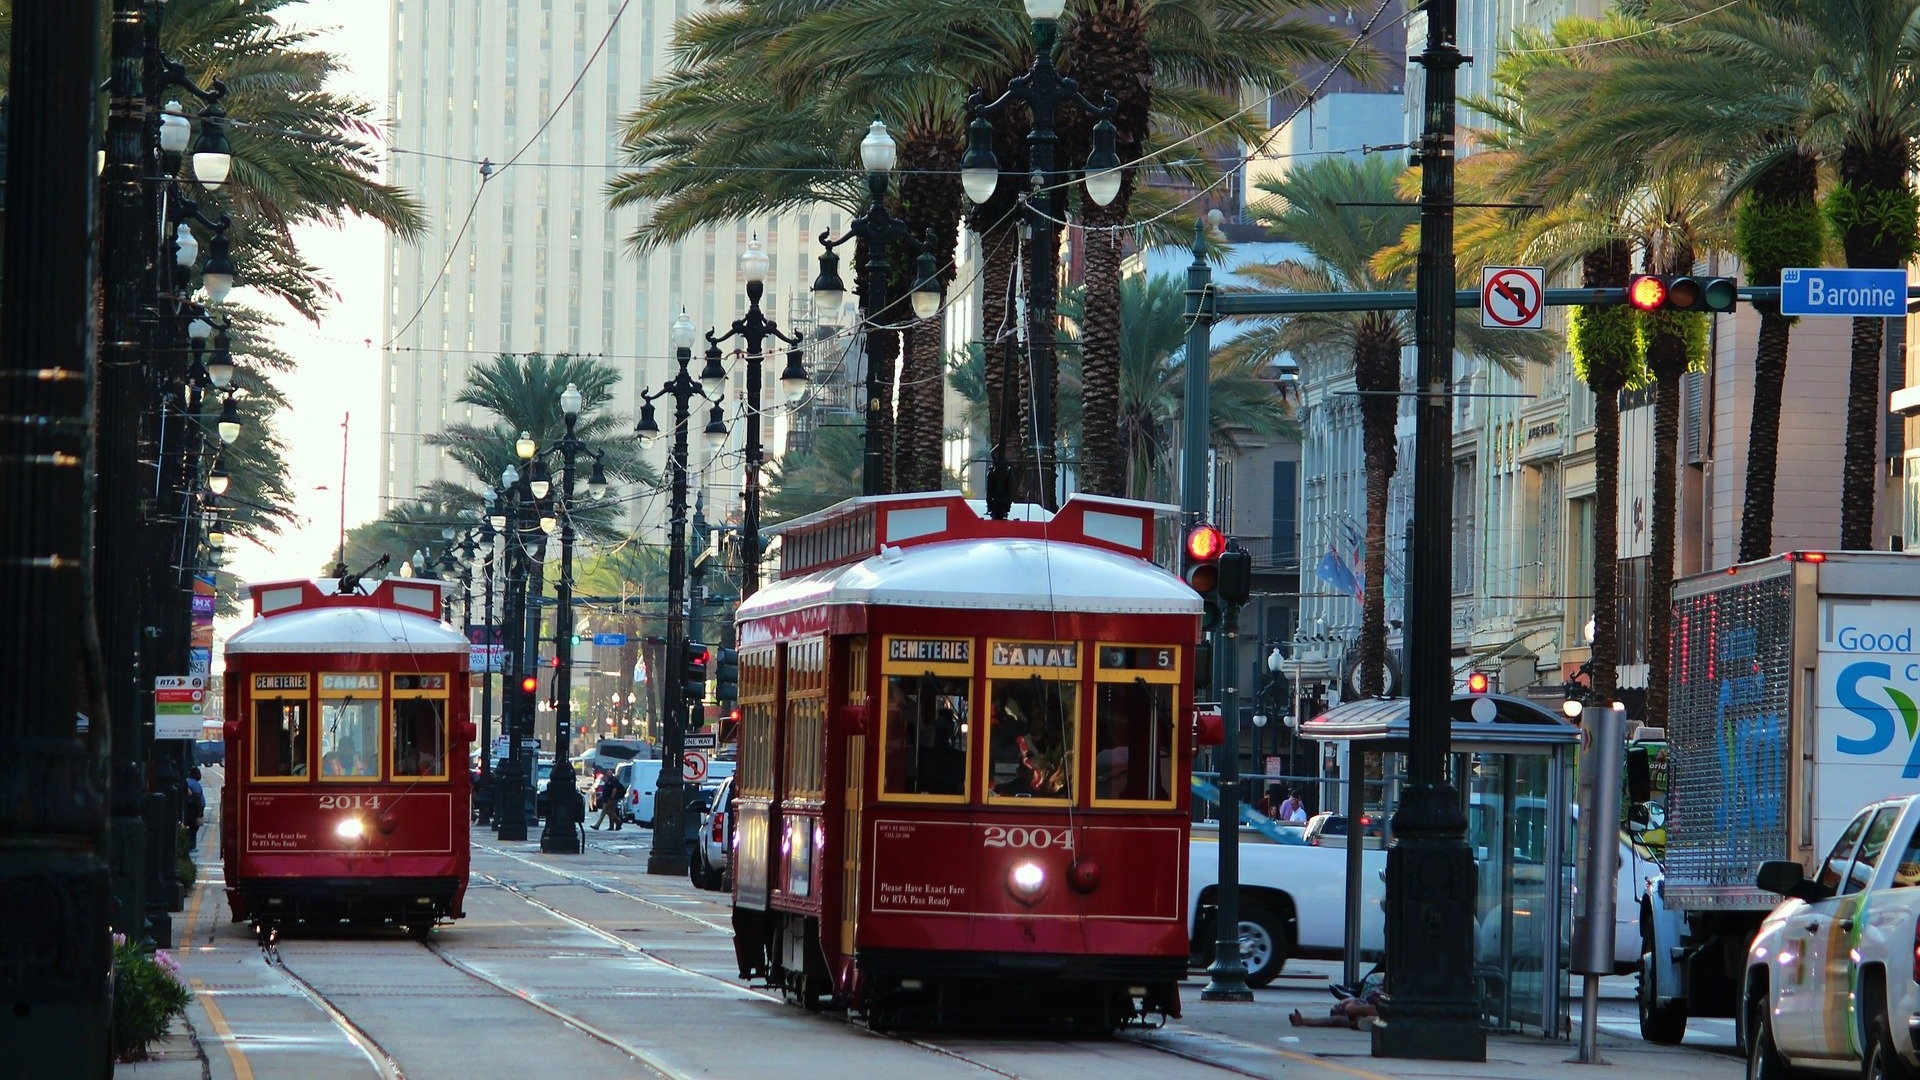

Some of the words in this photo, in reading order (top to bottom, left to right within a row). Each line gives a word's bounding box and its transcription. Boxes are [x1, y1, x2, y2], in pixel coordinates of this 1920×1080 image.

[1808, 277, 1896, 307] Baronne
[603, 635, 620, 645] Camp
[1838, 627, 1912, 652] Good
[891, 640, 969, 660] CEMETERIES
[993, 645, 1076, 667] CANAL
[1157, 651, 1169, 667] 5
[256, 675, 308, 689] CEMETERIES
[323, 675, 378, 689] CANAL
[698, 738, 711, 746] WAY
[319, 795, 380, 810] 2014
[282, 840, 298, 848] Ready
[983, 826, 1075, 850] 2004
[880, 882, 902, 892] Please
[904, 883, 923, 893] Have
[925, 884, 947, 894] Exact
[949, 885, 965, 895] Fare
[880, 894, 890, 904] Or
[892, 895, 908, 904] RTA
[909, 896, 926, 905] Pass
[928, 896, 951, 907] Ready
